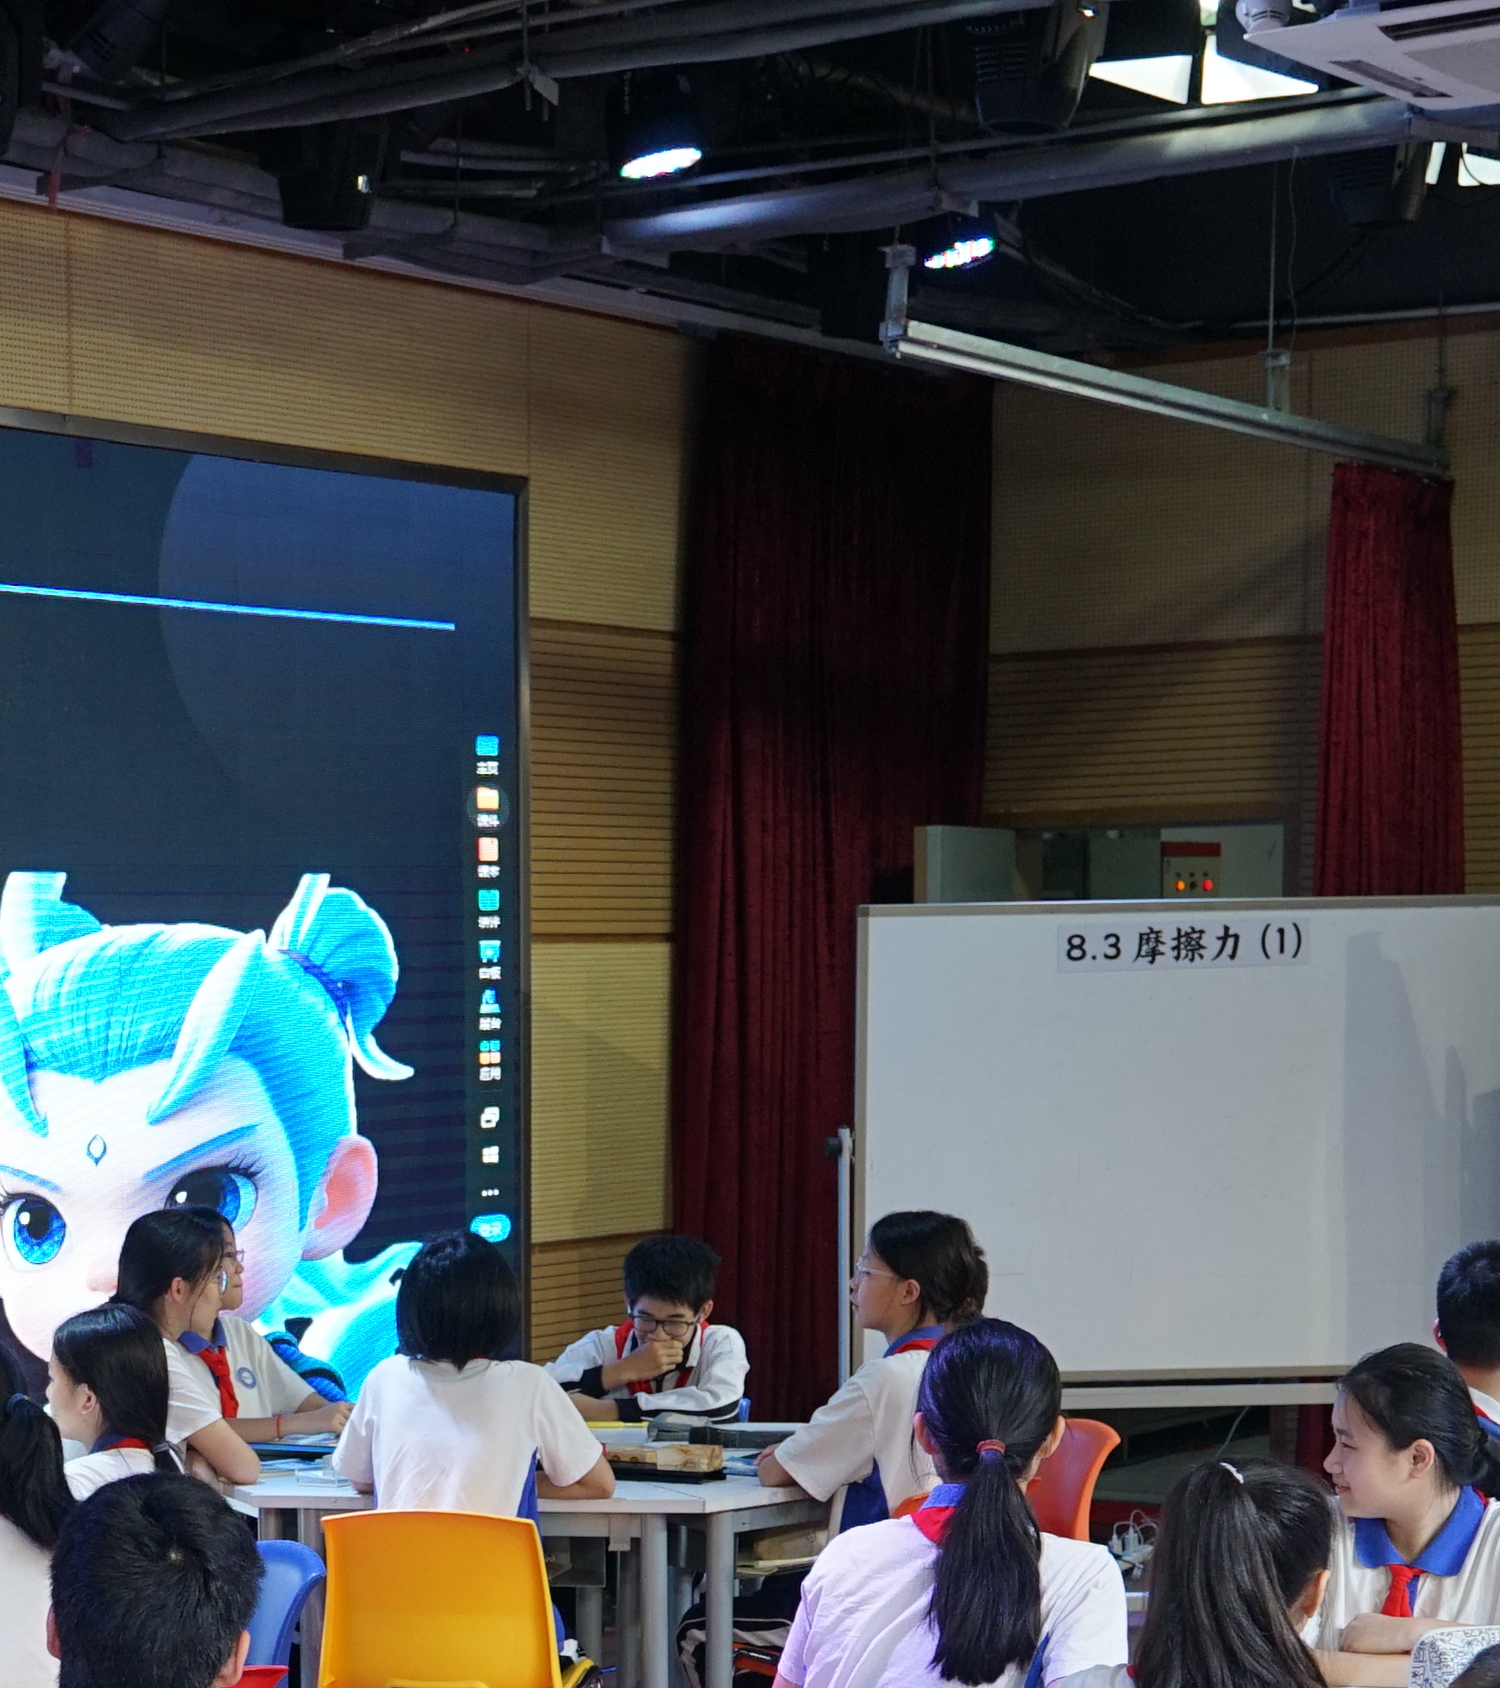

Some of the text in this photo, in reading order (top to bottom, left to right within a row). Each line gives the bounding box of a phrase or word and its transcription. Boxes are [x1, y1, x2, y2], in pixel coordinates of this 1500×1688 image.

[1066, 933, 1122, 962] 8.3
[1133, 924, 1240, 965] 摩擦力
